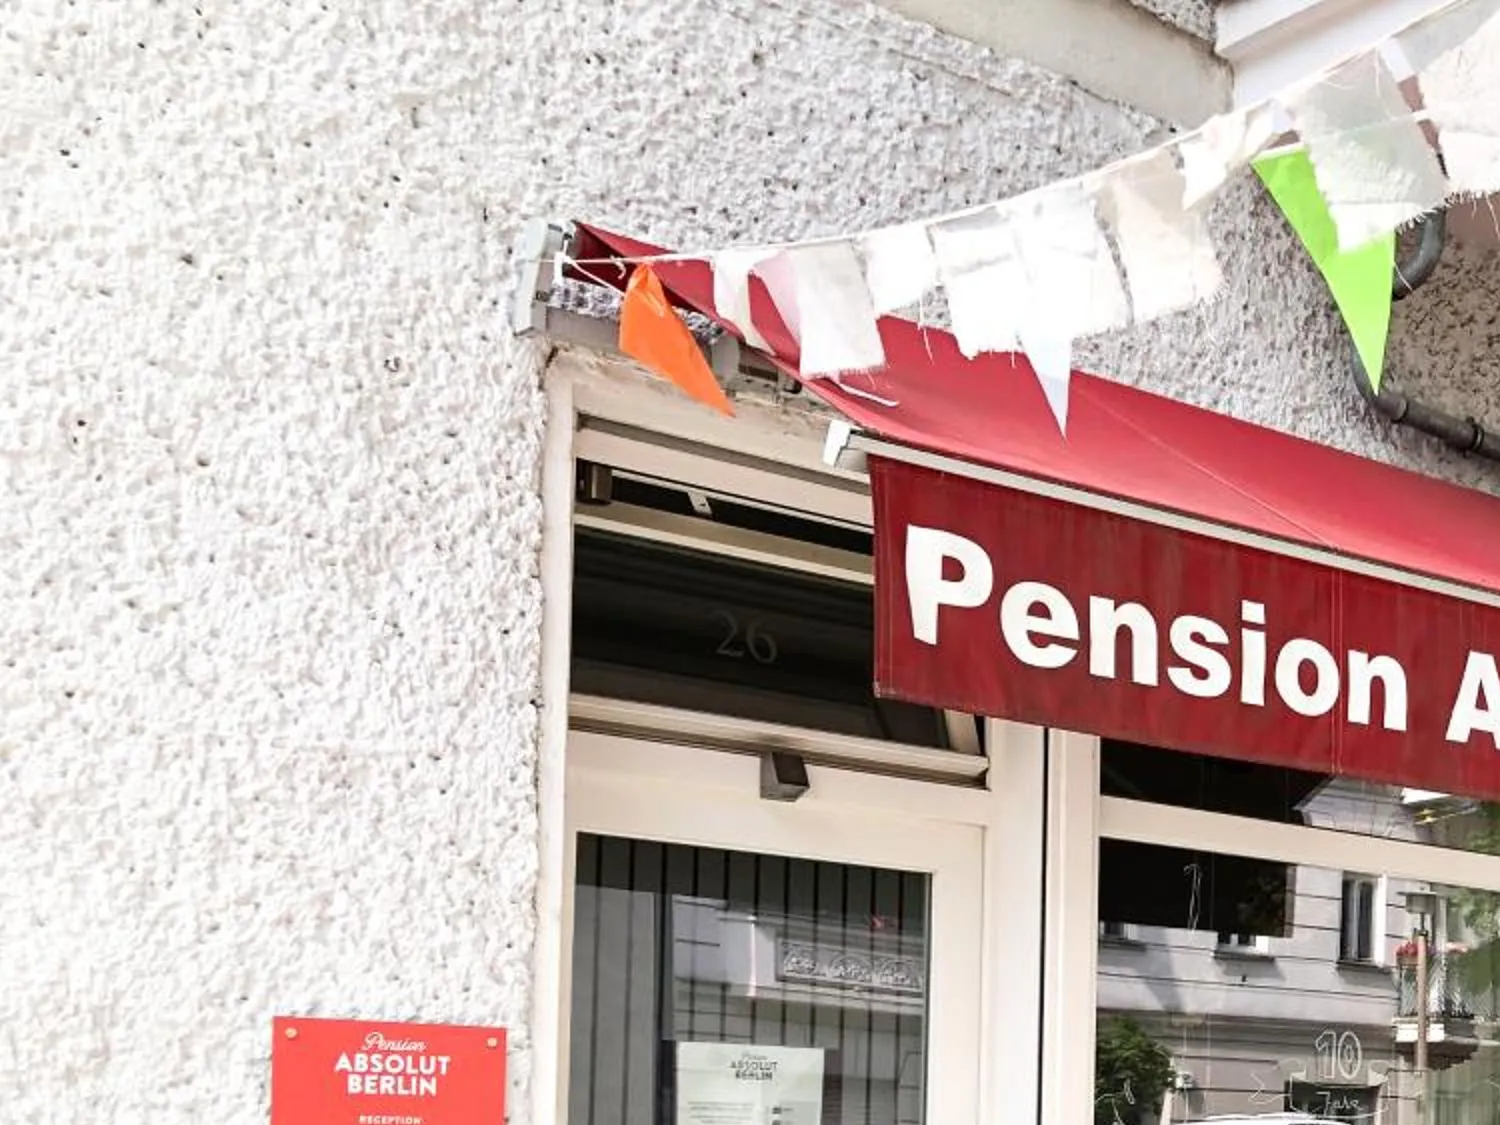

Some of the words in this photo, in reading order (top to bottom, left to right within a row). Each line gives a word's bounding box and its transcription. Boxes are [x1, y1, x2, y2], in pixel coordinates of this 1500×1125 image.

[711, 609, 778, 664] 26
[905, 523, 1408, 732] Pension
[362, 1032, 427, 1052] Pension
[334, 1053, 450, 1075] ABSOLUT
[1315, 1030, 1362, 1080] 10
[347, 1074, 437, 1096] BERLIN
[359, 1115, 422, 1125] RECEPTION
